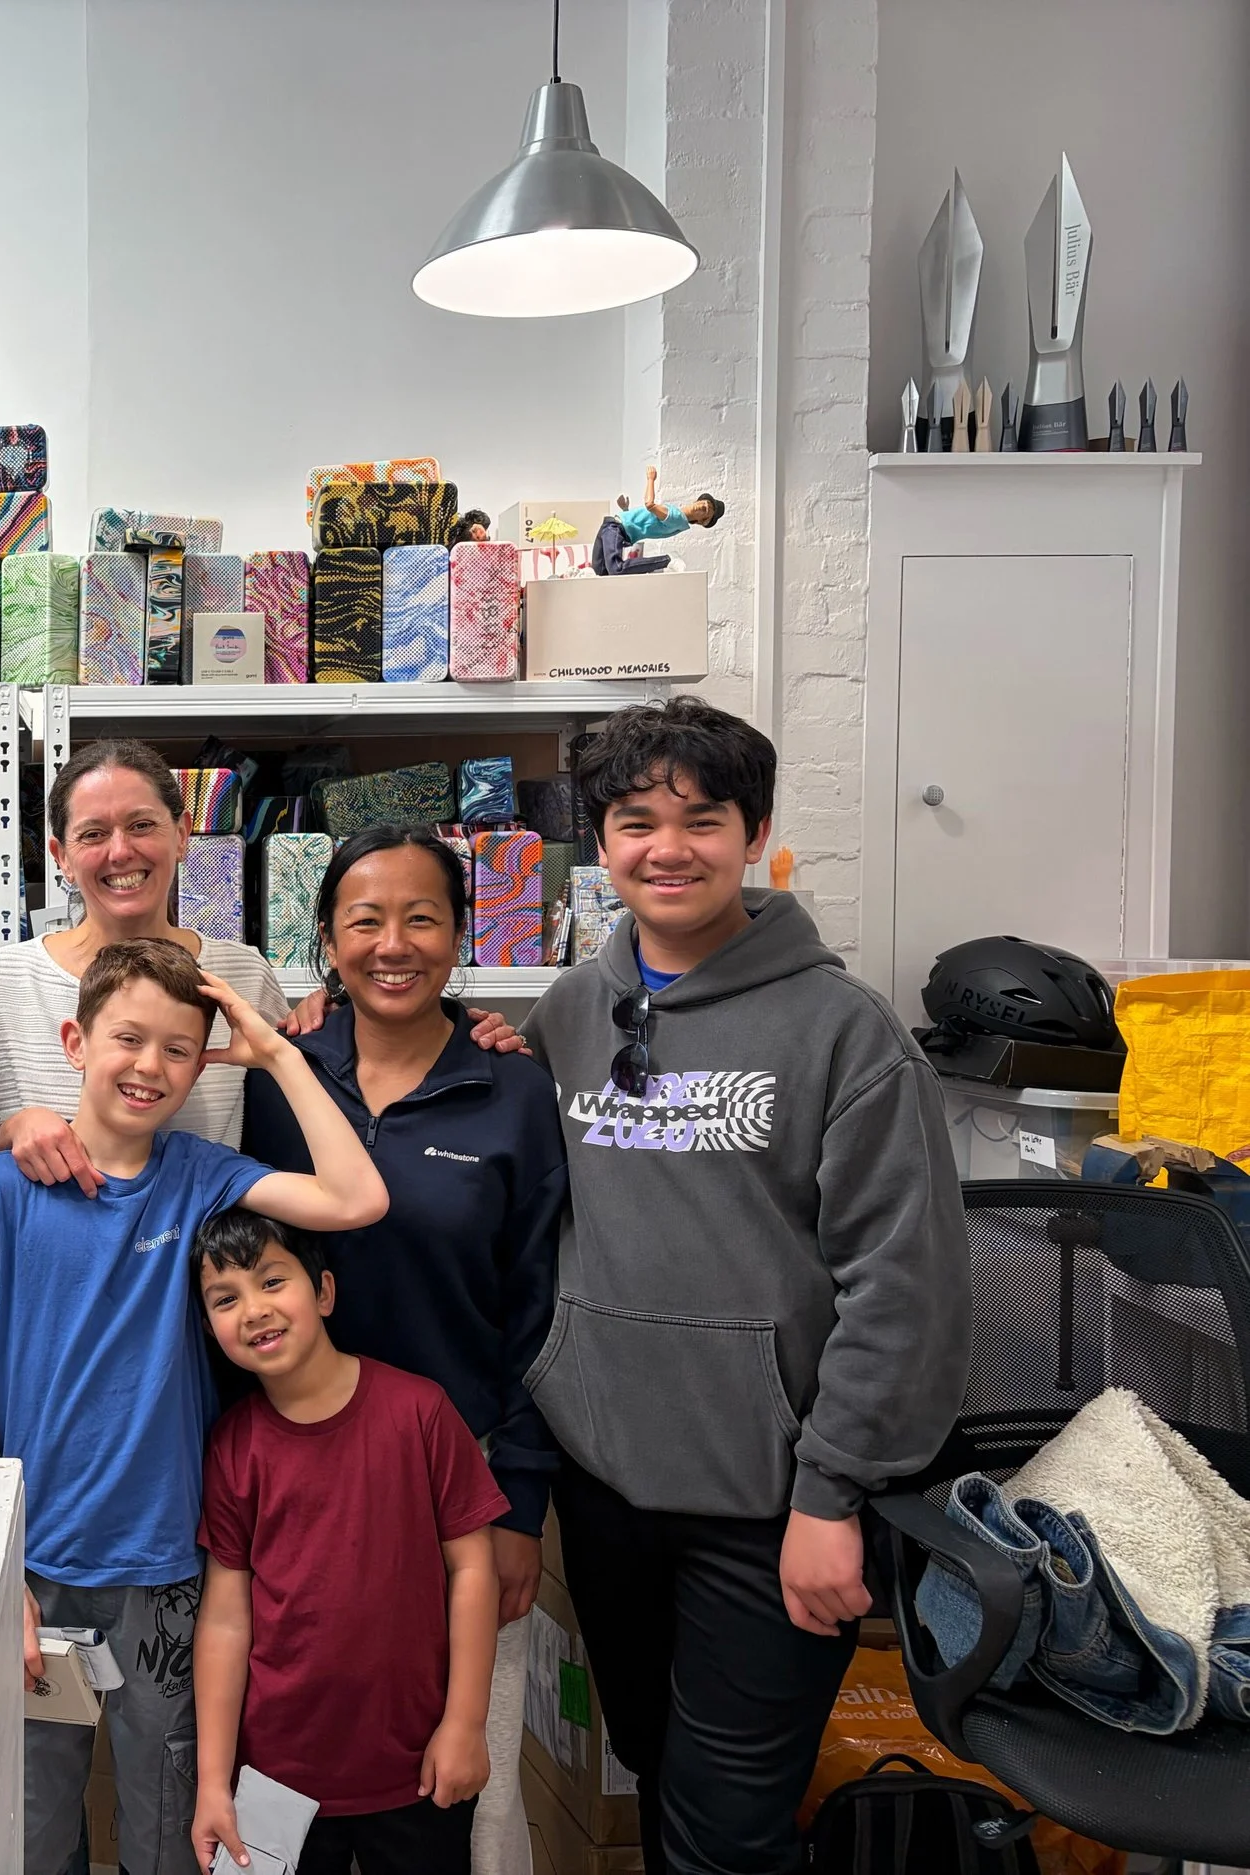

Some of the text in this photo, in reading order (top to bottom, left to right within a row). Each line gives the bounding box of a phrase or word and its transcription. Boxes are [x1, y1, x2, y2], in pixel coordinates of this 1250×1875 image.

[1064, 223, 1081, 297] Julius Bär
[549, 663, 670, 678] CHILDHOOD MEMORIES
[577, 1093, 728, 1127] Wrapped
[437, 1150, 480, 1163] whitestone
[134, 1223, 180, 1253] element
[136, 1631, 192, 1683] NYC
[830, 1710, 879, 1720] Good
